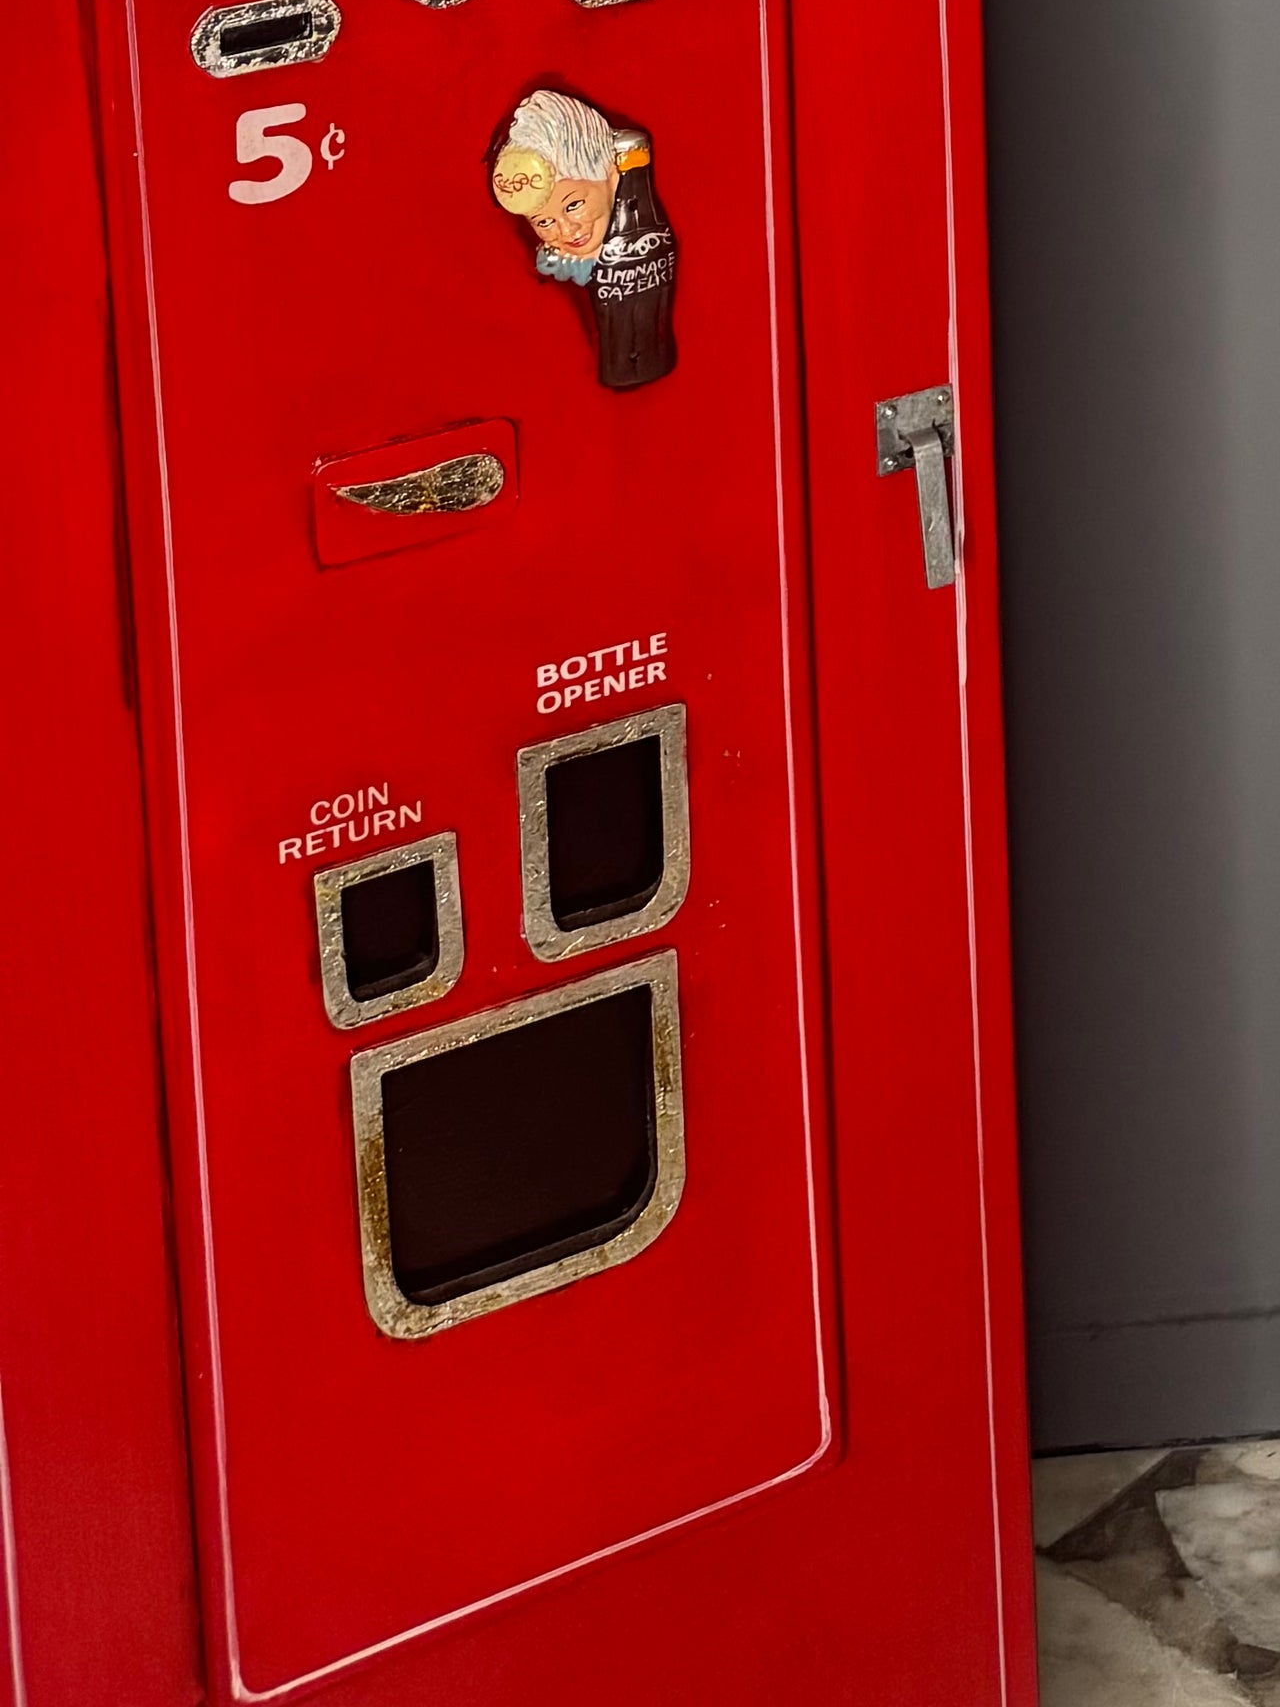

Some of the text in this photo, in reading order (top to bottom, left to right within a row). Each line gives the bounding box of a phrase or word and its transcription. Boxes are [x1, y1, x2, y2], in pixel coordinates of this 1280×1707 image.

[536, 632, 668, 688] BOTTLE
[536, 661, 667, 714] OPENER
[310, 782, 389, 826] COIN
[278, 800, 422, 865] RETURN
